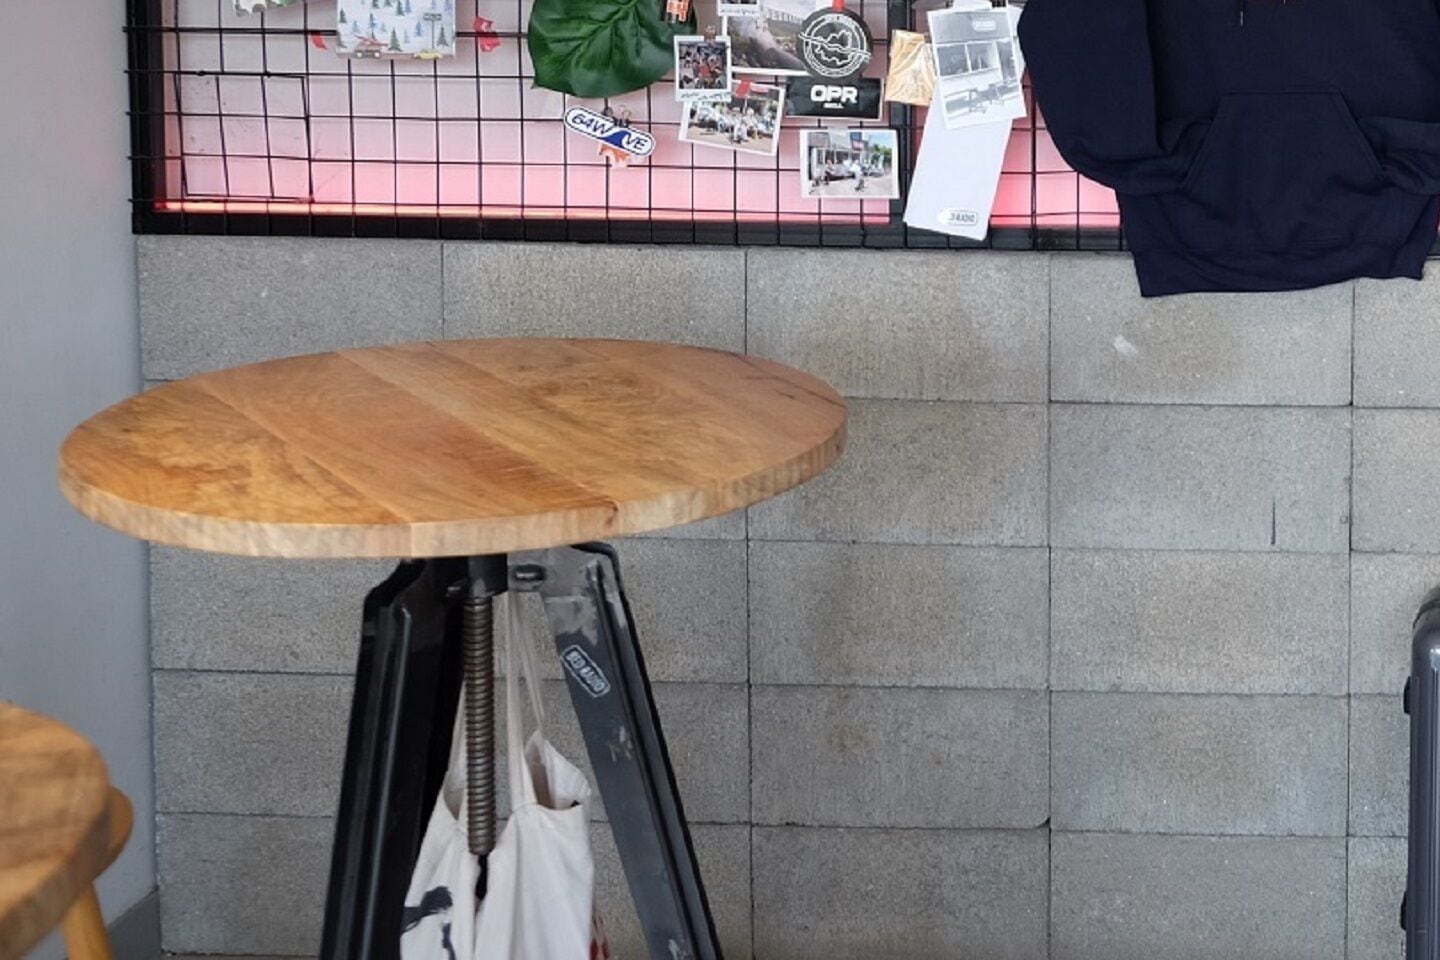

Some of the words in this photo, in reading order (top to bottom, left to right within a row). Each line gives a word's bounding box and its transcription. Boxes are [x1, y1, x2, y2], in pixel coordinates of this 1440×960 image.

[810, 84, 858, 104] OPR
[566, 650, 586, 669] BED
[580, 666, 605, 692] RADIO
